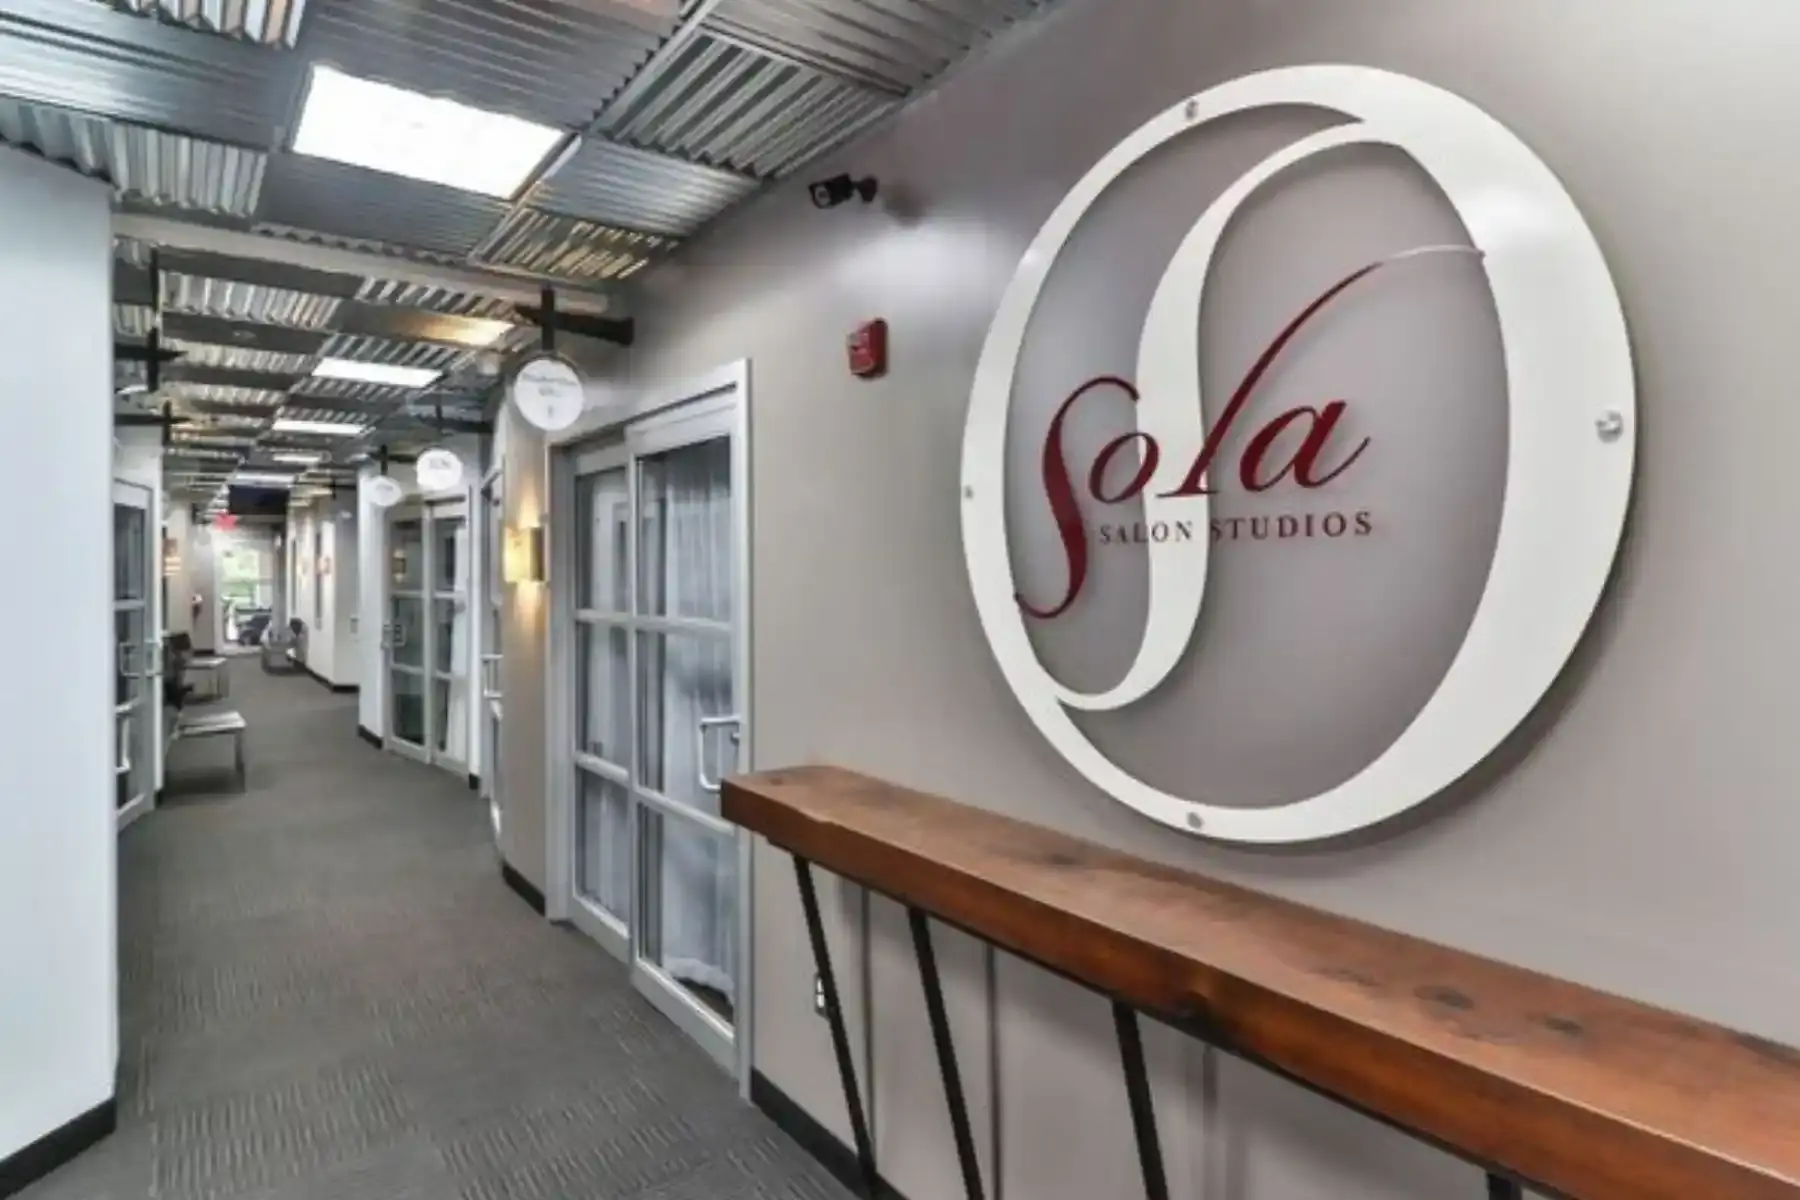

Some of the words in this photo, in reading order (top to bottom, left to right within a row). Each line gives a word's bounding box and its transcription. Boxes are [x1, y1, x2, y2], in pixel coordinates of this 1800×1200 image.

[1014, 246, 1484, 619] Sola
[1099, 519, 1194, 545] SALON
[1208, 510, 1374, 543] STUDIOS
